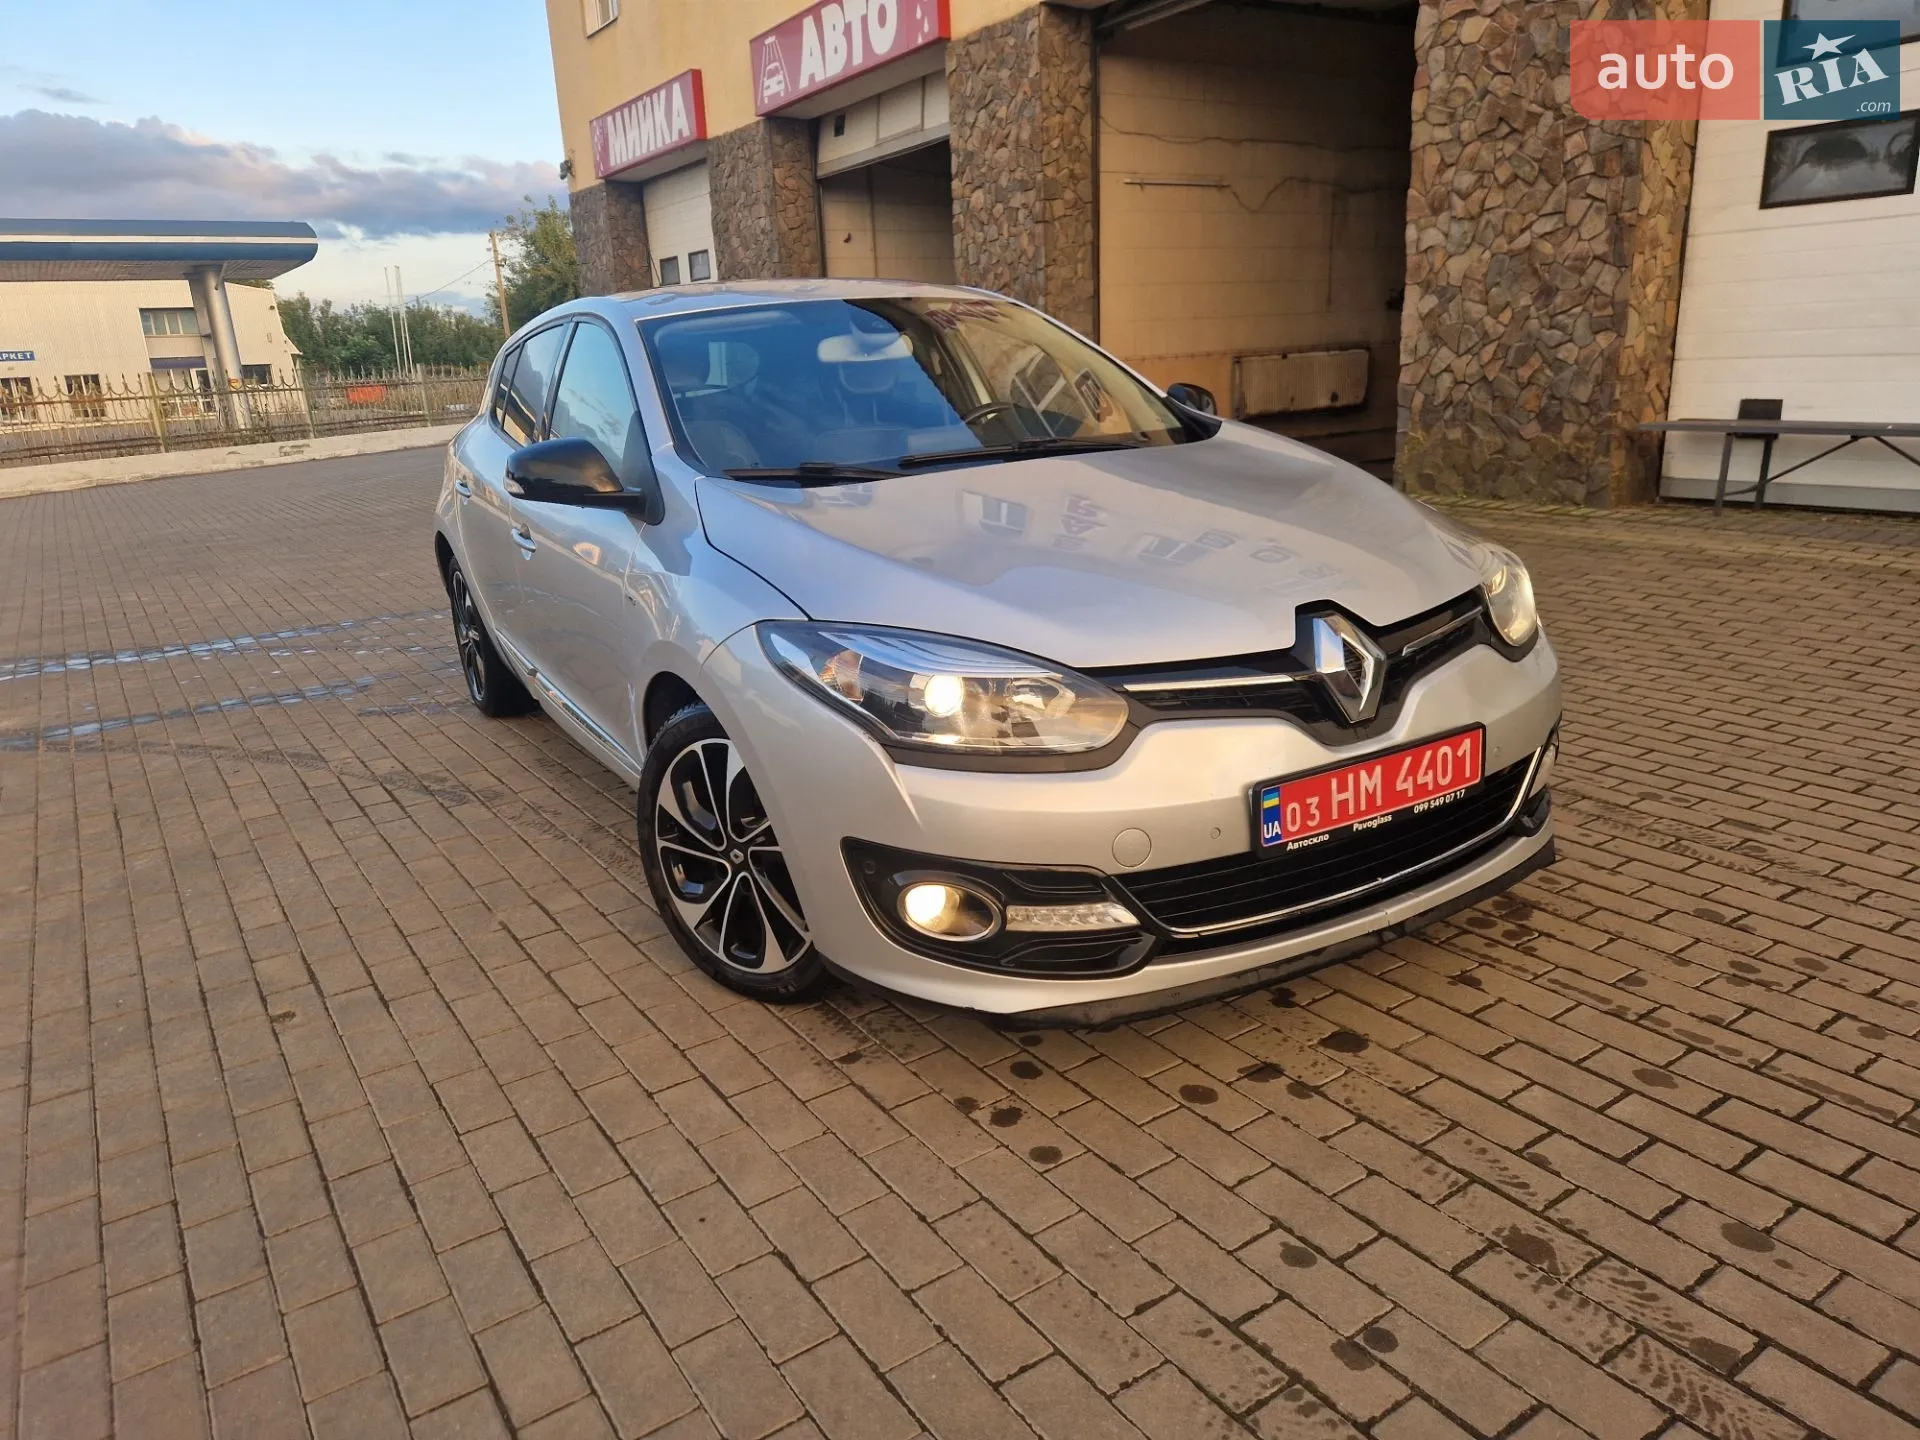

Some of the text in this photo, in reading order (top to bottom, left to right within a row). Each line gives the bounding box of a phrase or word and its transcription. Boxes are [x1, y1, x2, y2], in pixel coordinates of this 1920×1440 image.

[799, 0, 897, 88] АВТО
[607, 81, 691, 167] МИЙКА
[1286, 738, 1471, 832] 03 HM 4401
[1413, 789, 1466, 814] 099 549 07 17
[1264, 822, 1281, 838] UA
[1353, 814, 1393, 832] Pavoglass
[1287, 834, 1330, 851] Автоскло
